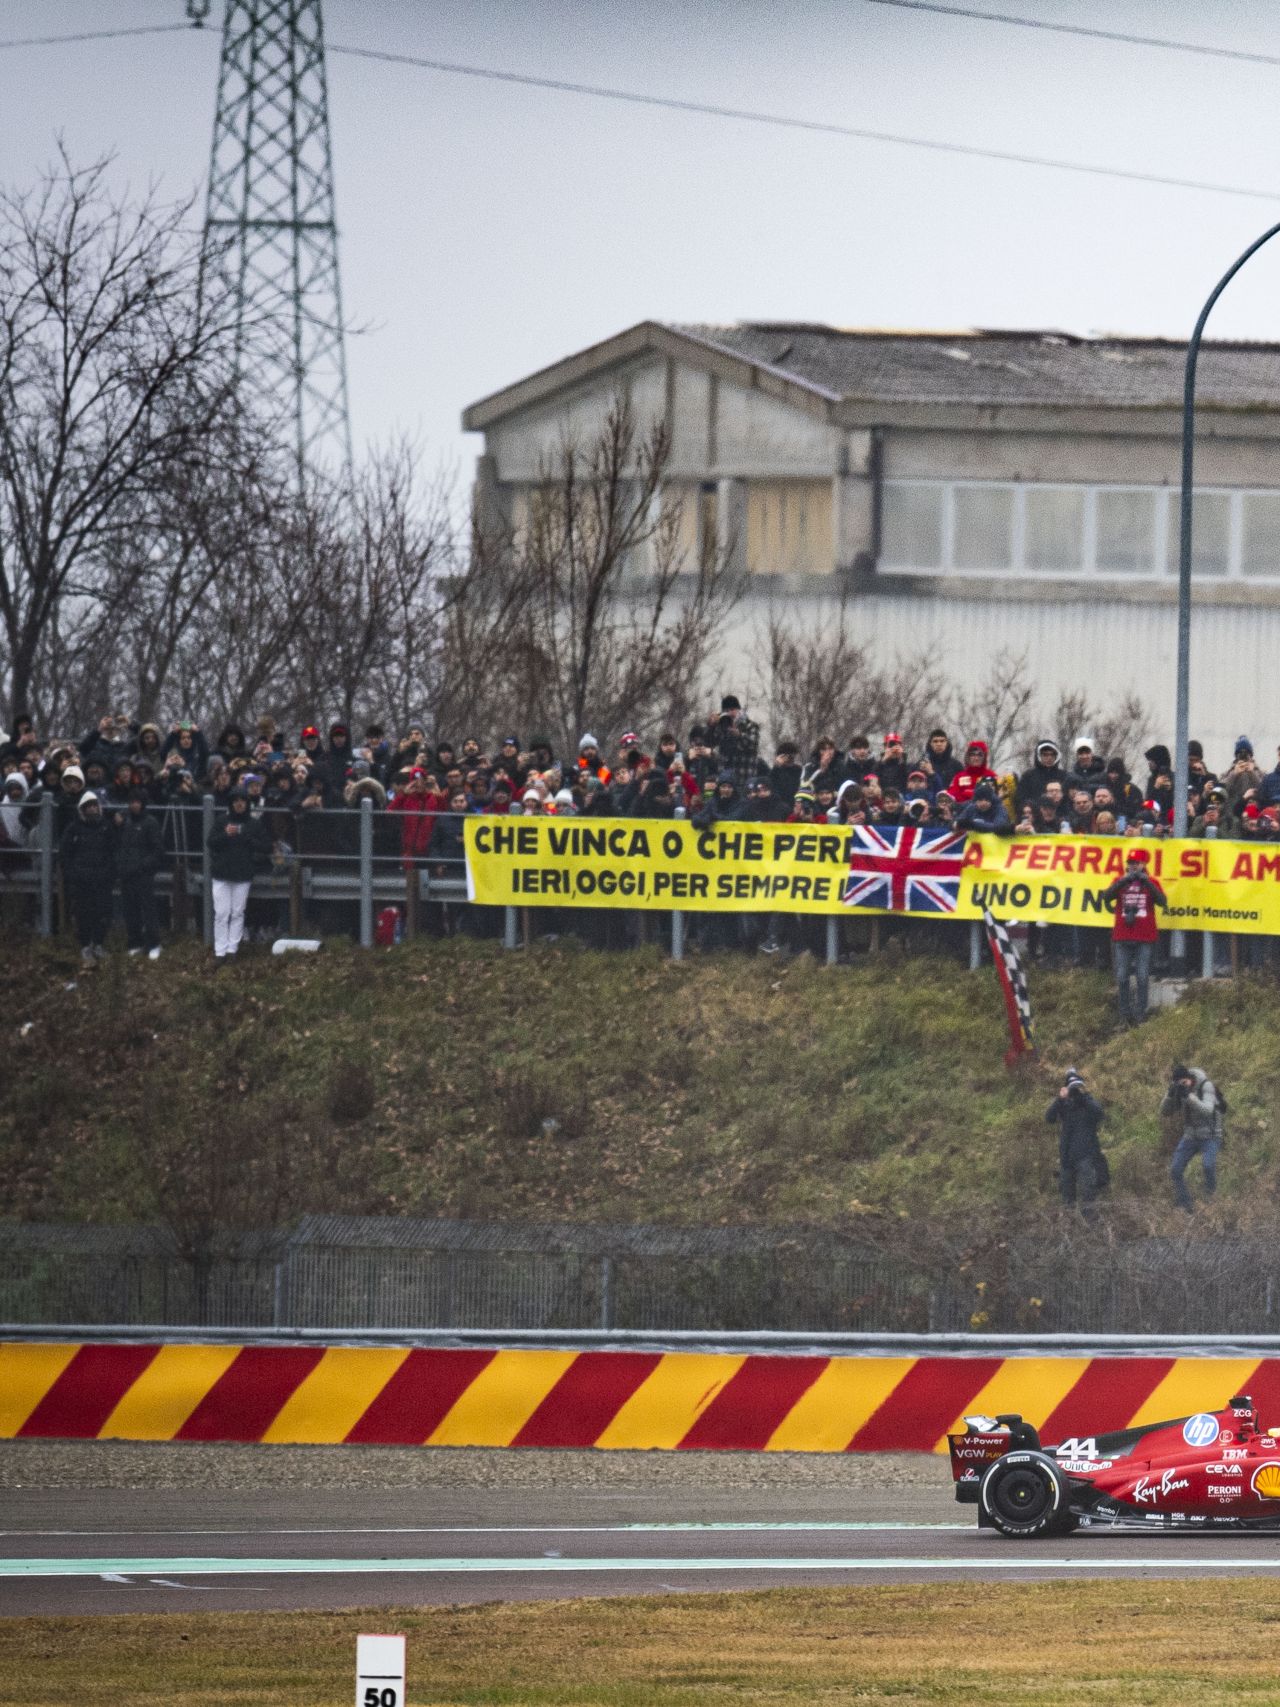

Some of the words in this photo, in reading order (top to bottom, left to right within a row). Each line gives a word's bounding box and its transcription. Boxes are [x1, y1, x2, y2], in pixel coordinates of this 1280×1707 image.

[475, 826, 538, 854] CHE
[548, 828, 650, 858] VINCA
[662, 830, 684, 859] O
[697, 832, 763, 860] CHE
[773, 834, 851, 863] PER
[717, 874, 830, 900] SEMPRE
[971, 883, 1031, 908] UNO
[1040, 886, 1072, 910] DI
[1081, 889, 1118, 914] NO
[1203, 907, 1259, 920] Mantova
[1187, 1415, 1215, 1446] hp
[963, 1437, 1003, 1445] V-Power
[956, 1449, 985, 1458] VGW
[1056, 1438, 1099, 1461] 44
[1222, 1449, 1248, 1459] IBM
[1208, 1485, 1241, 1494] PERONI
[364, 1687, 397, 1707] 50
